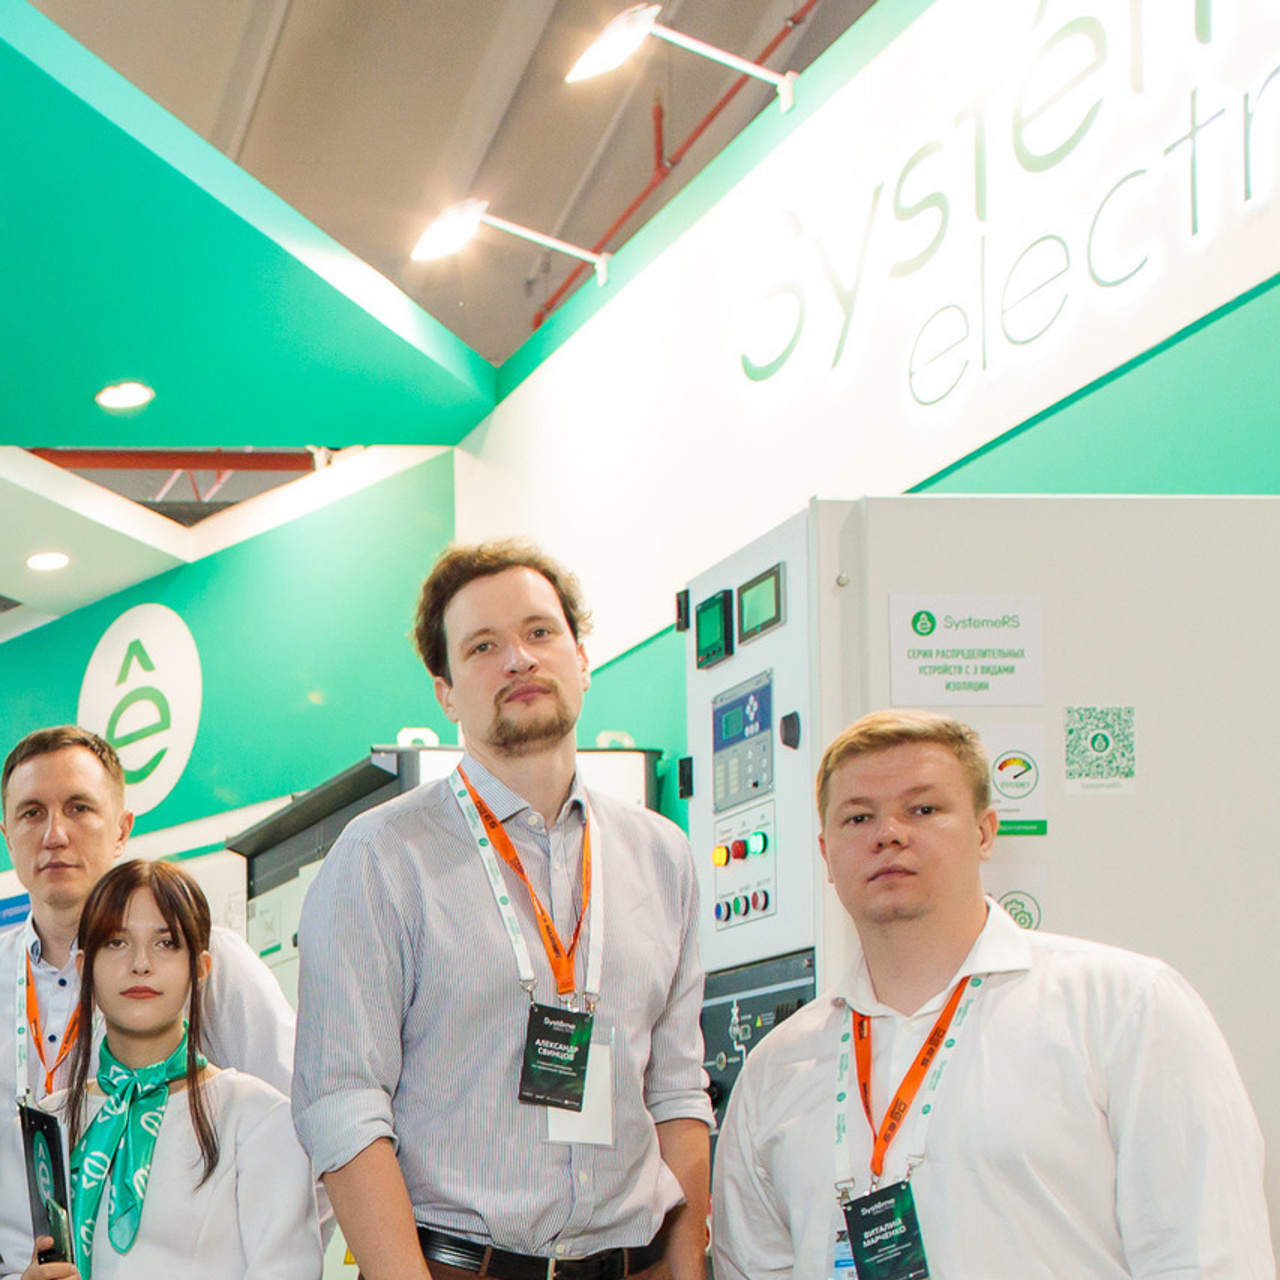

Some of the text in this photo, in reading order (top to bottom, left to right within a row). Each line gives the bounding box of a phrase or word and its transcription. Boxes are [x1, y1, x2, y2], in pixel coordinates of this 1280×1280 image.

[944, 615, 1020, 630] SystemeRS
[907, 648, 1025, 659] СЕРИЯ РАСПРЕДЕЛИТЕЛЬНЫХ
[919, 664, 962, 675] УСТРОЙСТВ
[980, 665, 1016, 676] ВИДАМИ
[945, 681, 989, 691] ИЗОЛЯЦИИ
[535, 1039, 579, 1053] АЛЕКСАНДР
